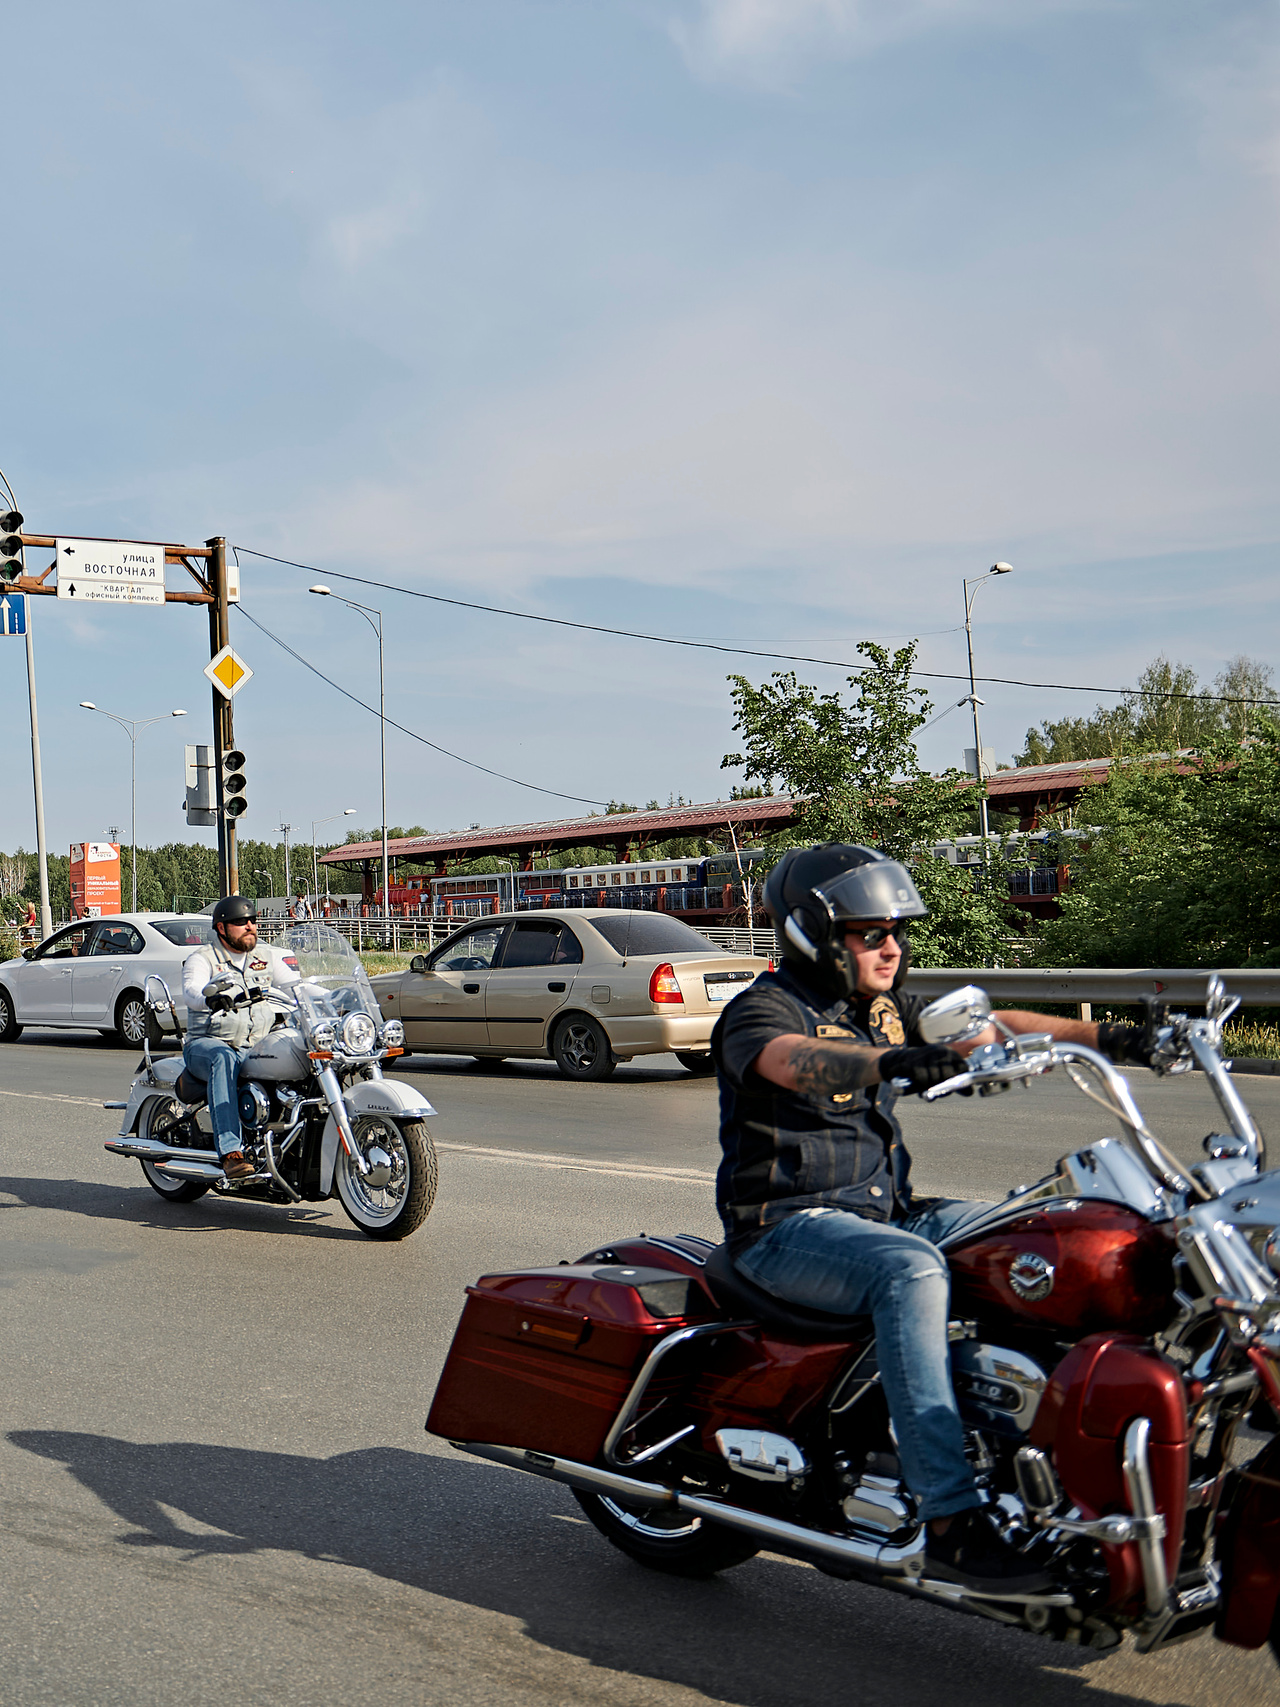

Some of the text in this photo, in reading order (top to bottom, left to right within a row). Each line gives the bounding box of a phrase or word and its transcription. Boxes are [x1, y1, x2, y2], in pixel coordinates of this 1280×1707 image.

[122, 553, 156, 564] улица
[84, 563, 156, 578] ВОСТОЧНАЯ
[85, 591, 160, 602] офисный комплекс
